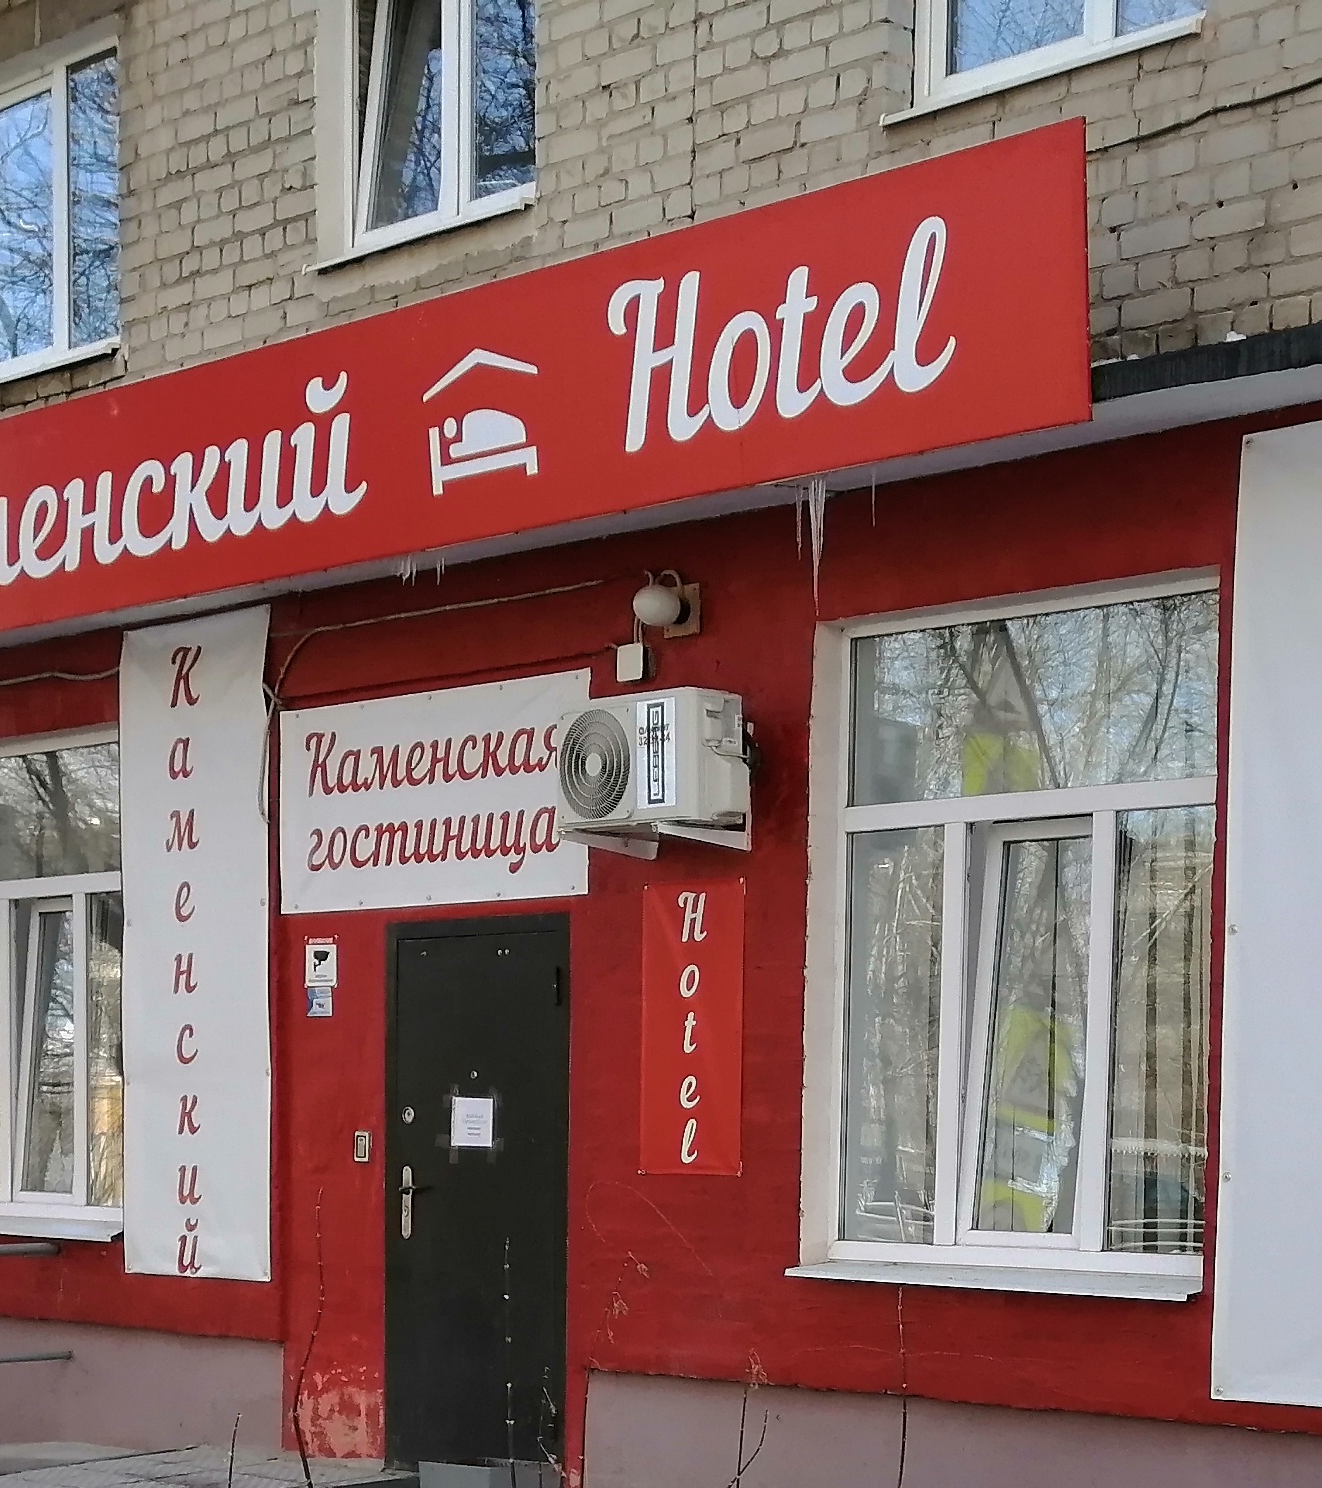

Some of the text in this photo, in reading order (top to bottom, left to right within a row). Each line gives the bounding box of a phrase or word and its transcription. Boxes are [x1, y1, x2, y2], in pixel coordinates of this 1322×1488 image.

[607, 216, 957, 453] Hotel
[165, 646, 201, 1275] Каменский
[307, 804, 561, 874] гостиница
[678, 891, 708, 1164] Hotel
